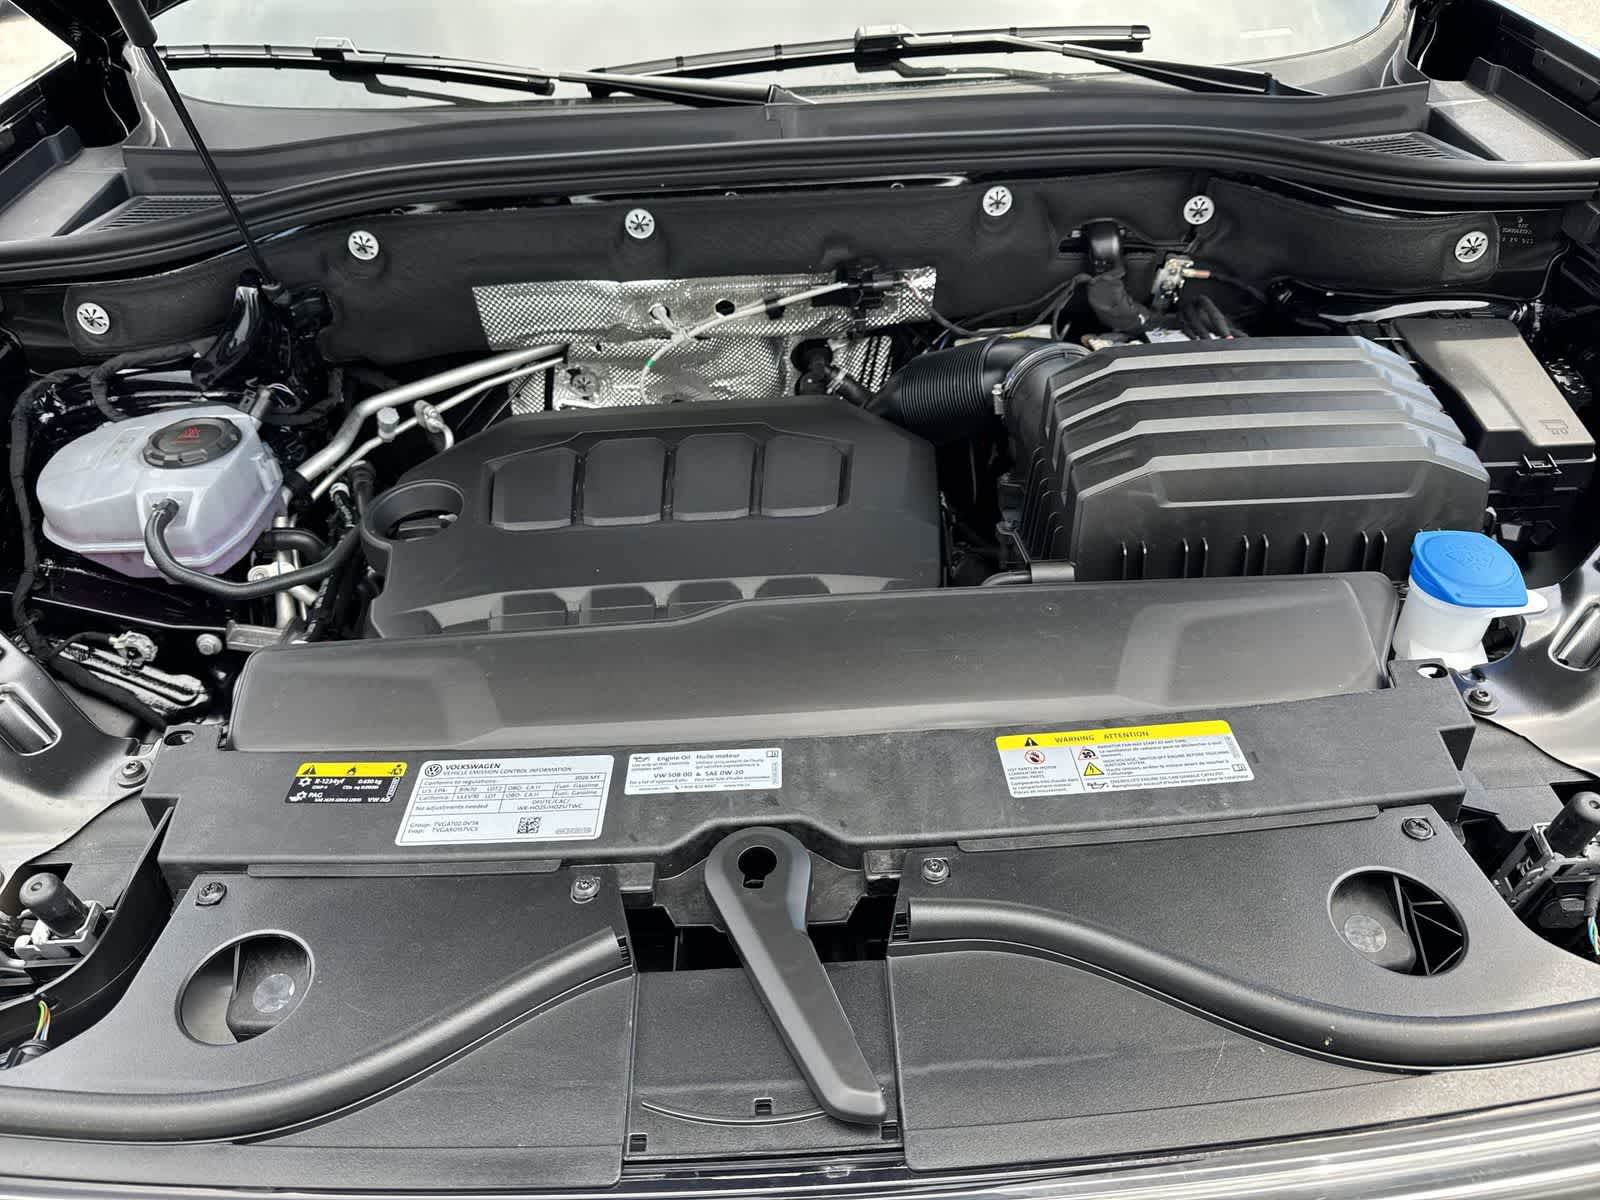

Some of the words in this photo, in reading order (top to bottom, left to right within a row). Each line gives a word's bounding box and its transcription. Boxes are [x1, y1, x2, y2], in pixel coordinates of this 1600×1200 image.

[1054, 735, 1095, 743] WARNING
[1104, 731, 1149, 740] ATTENTION
[445, 763, 501, 771] VOLKSWAGEN
